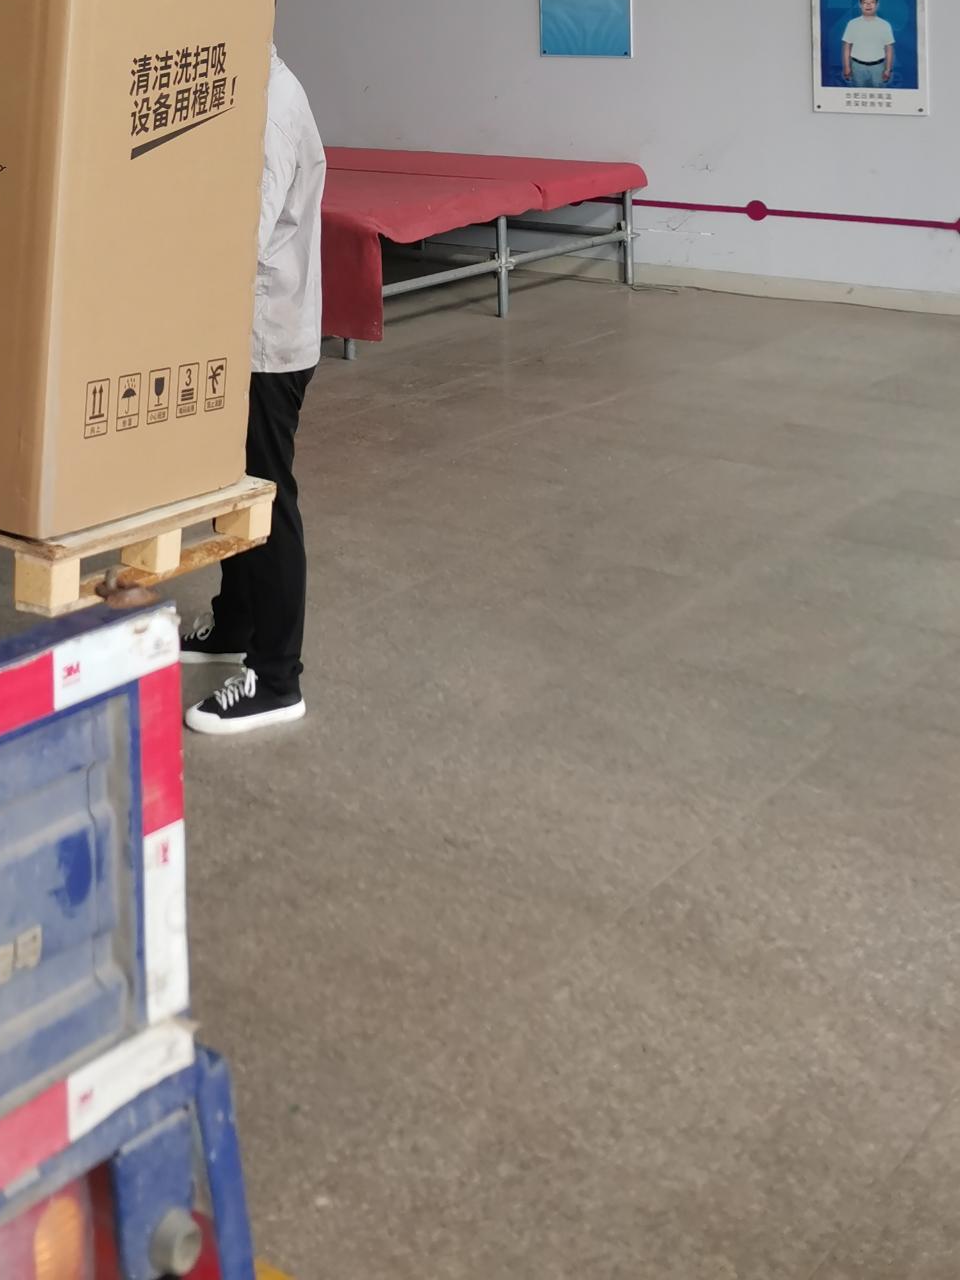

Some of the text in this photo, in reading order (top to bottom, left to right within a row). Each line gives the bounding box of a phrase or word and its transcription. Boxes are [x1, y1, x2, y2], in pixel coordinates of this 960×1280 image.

[129, 41, 227, 97] 清洁洗扫吸
